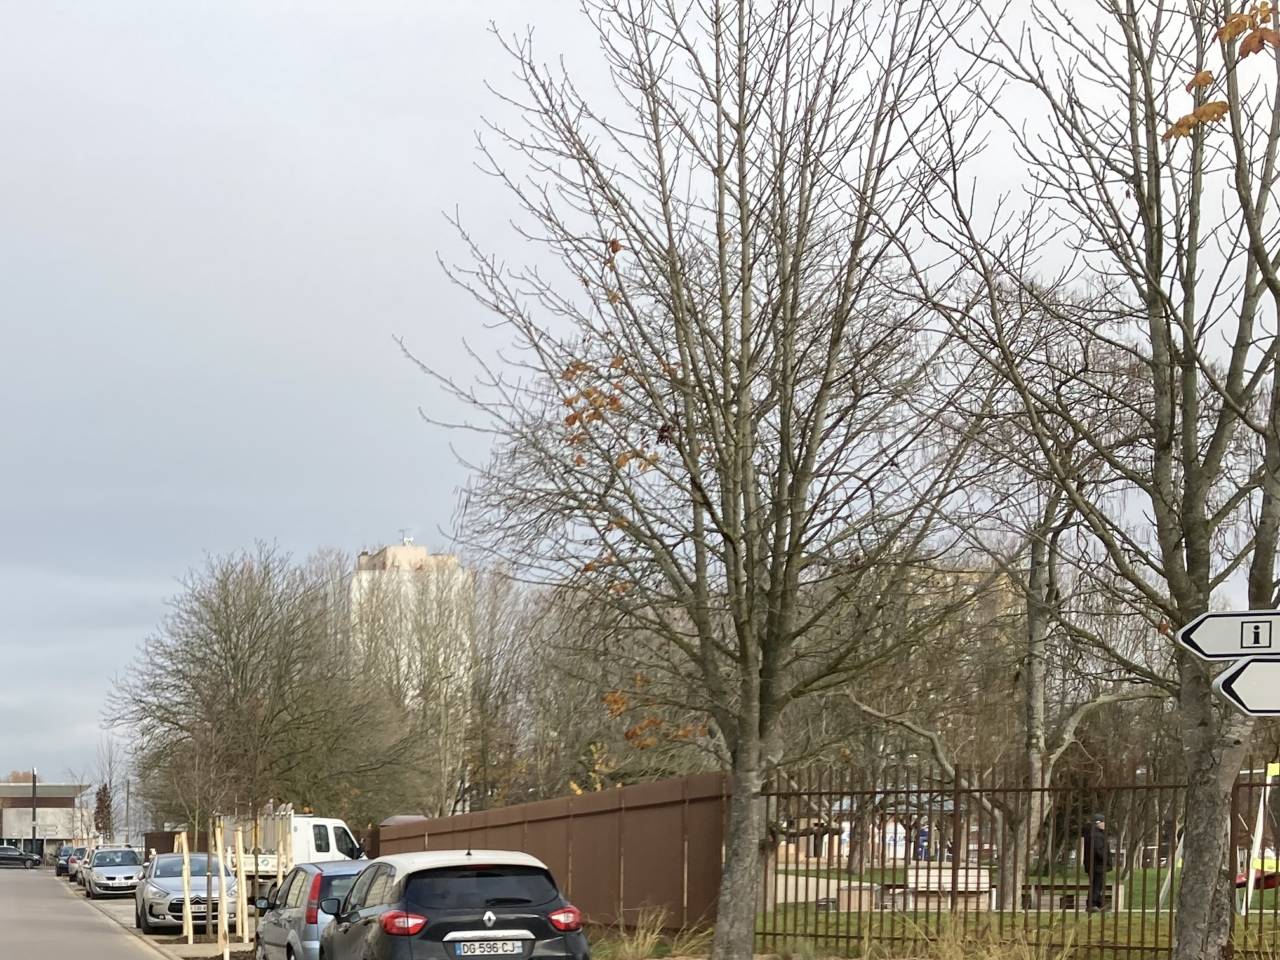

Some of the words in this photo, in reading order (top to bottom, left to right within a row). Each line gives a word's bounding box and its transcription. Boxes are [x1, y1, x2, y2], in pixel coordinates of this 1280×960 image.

[462, 943, 476, 954] DG
[479, 943, 499, 953] 596
[501, 942, 515, 953] CJ
